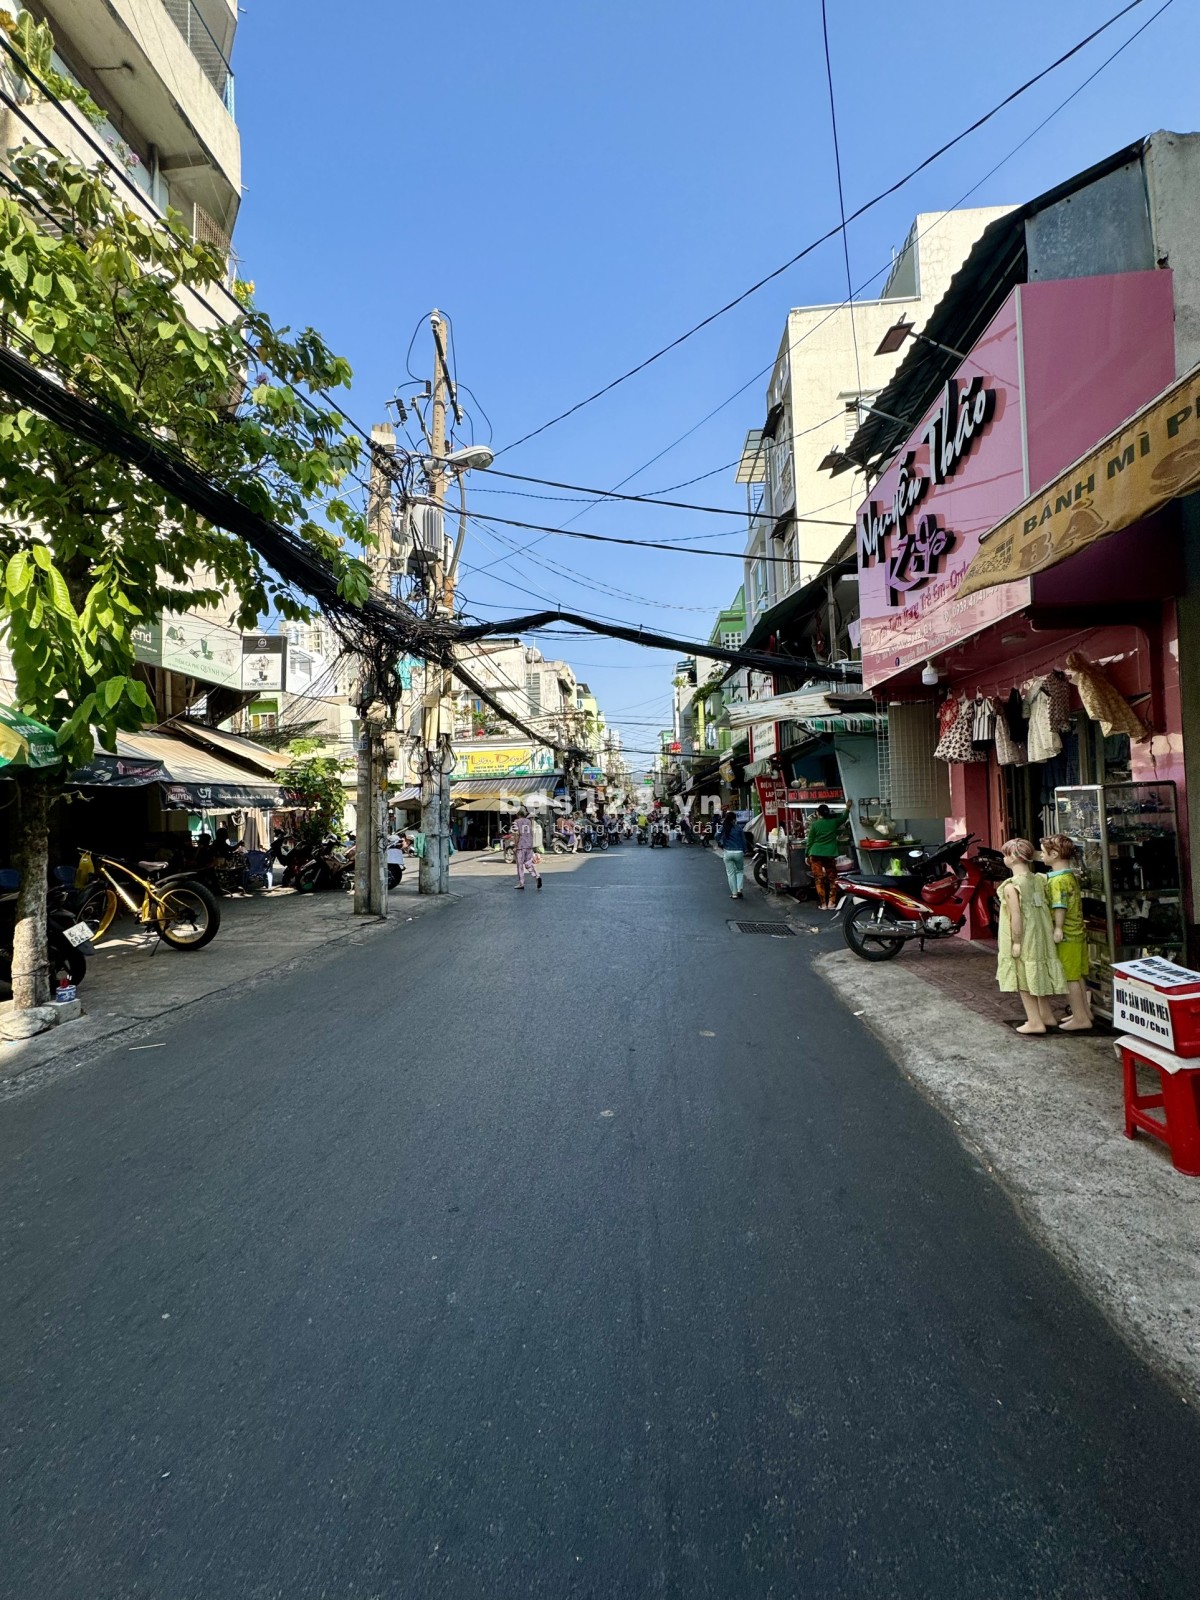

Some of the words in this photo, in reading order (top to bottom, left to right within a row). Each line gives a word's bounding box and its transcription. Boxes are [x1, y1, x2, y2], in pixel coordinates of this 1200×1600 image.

[1023, 474, 1095, 536] BÁNH
[1107, 431, 1150, 480] MÌ
[1120, 1009, 1170, 1037] 8.000/Chai
